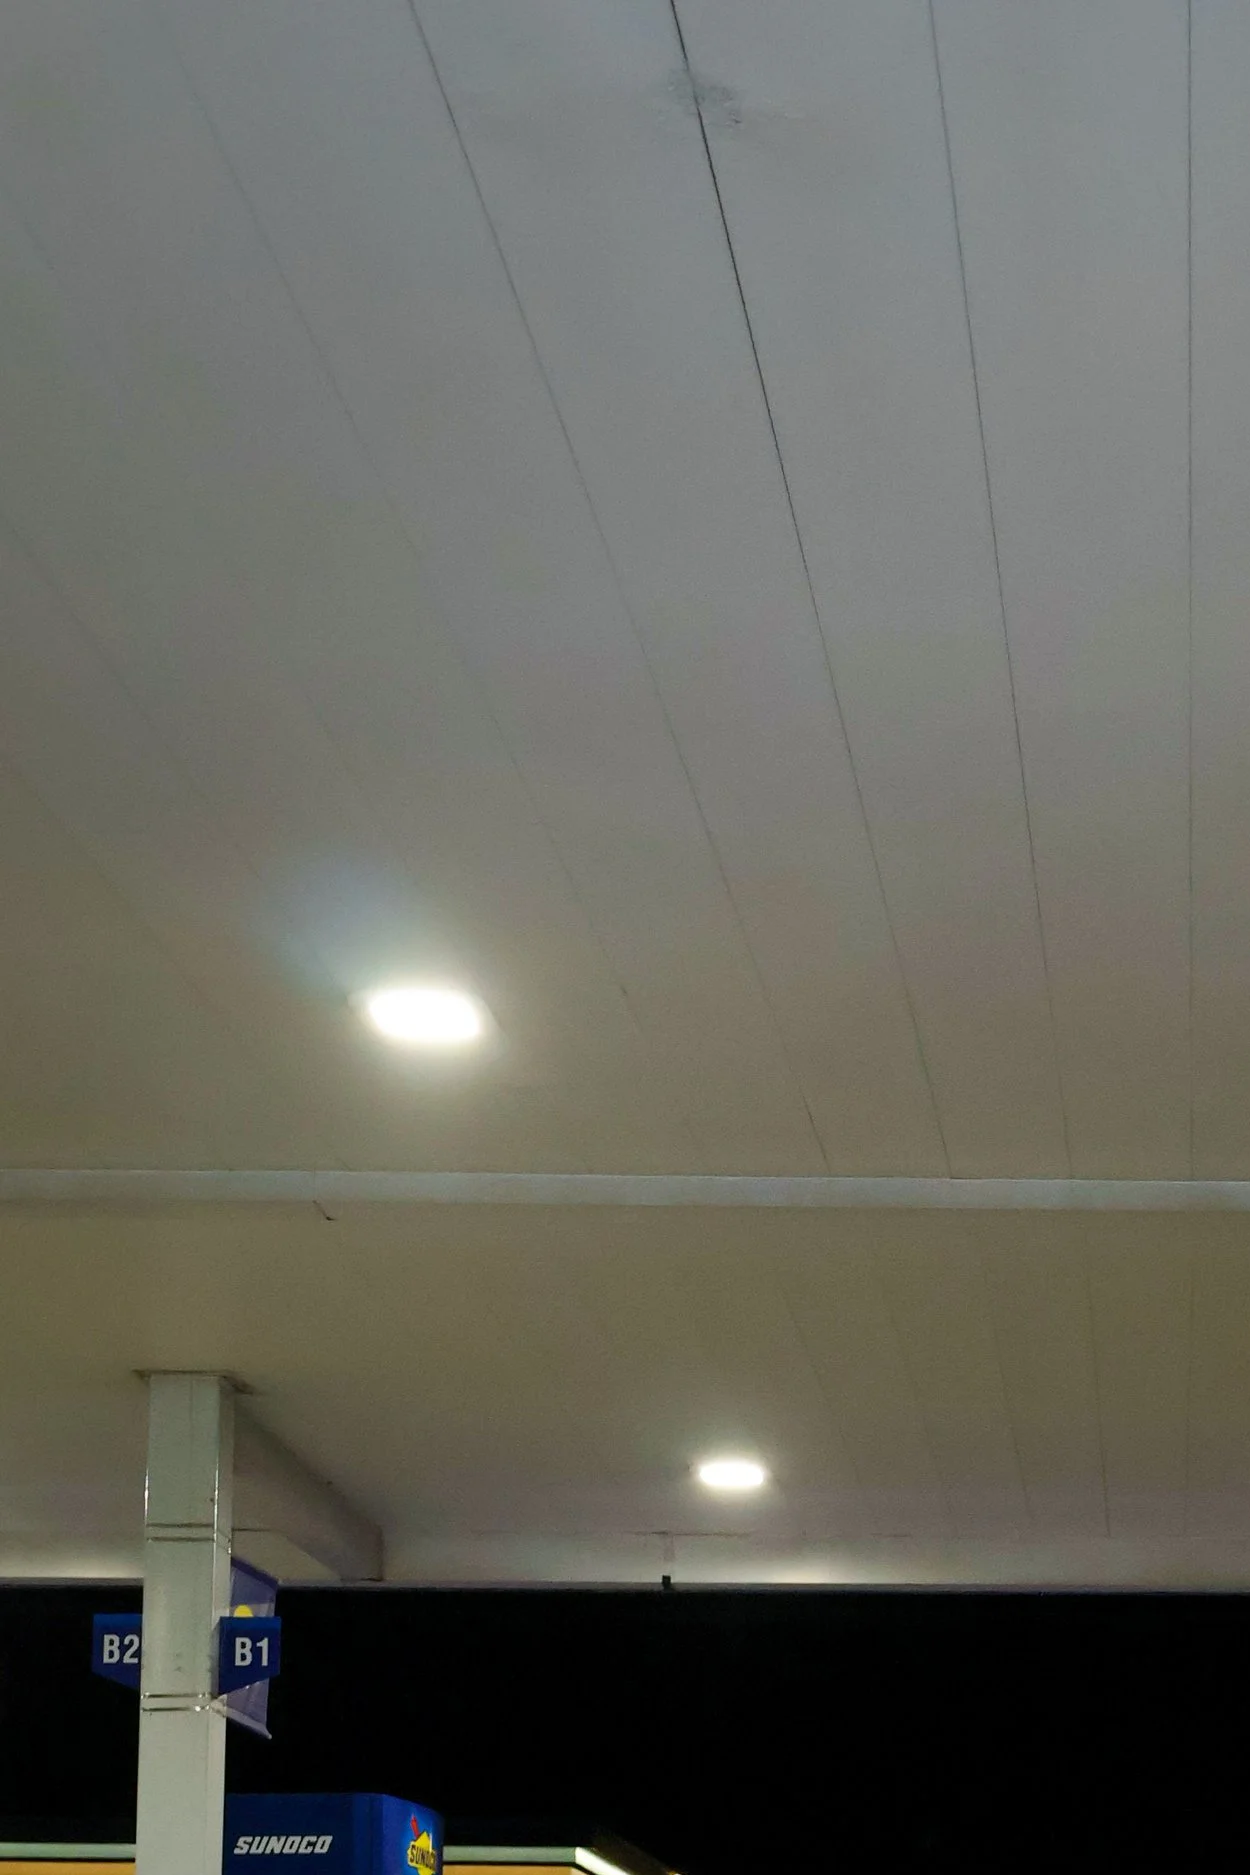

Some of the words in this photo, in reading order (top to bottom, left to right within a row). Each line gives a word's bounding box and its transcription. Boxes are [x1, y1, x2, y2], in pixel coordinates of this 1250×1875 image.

[103, 1633, 140, 1664] B2
[234, 1636, 269, 1667] B1
[233, 1835, 333, 1855] SUNOCO
